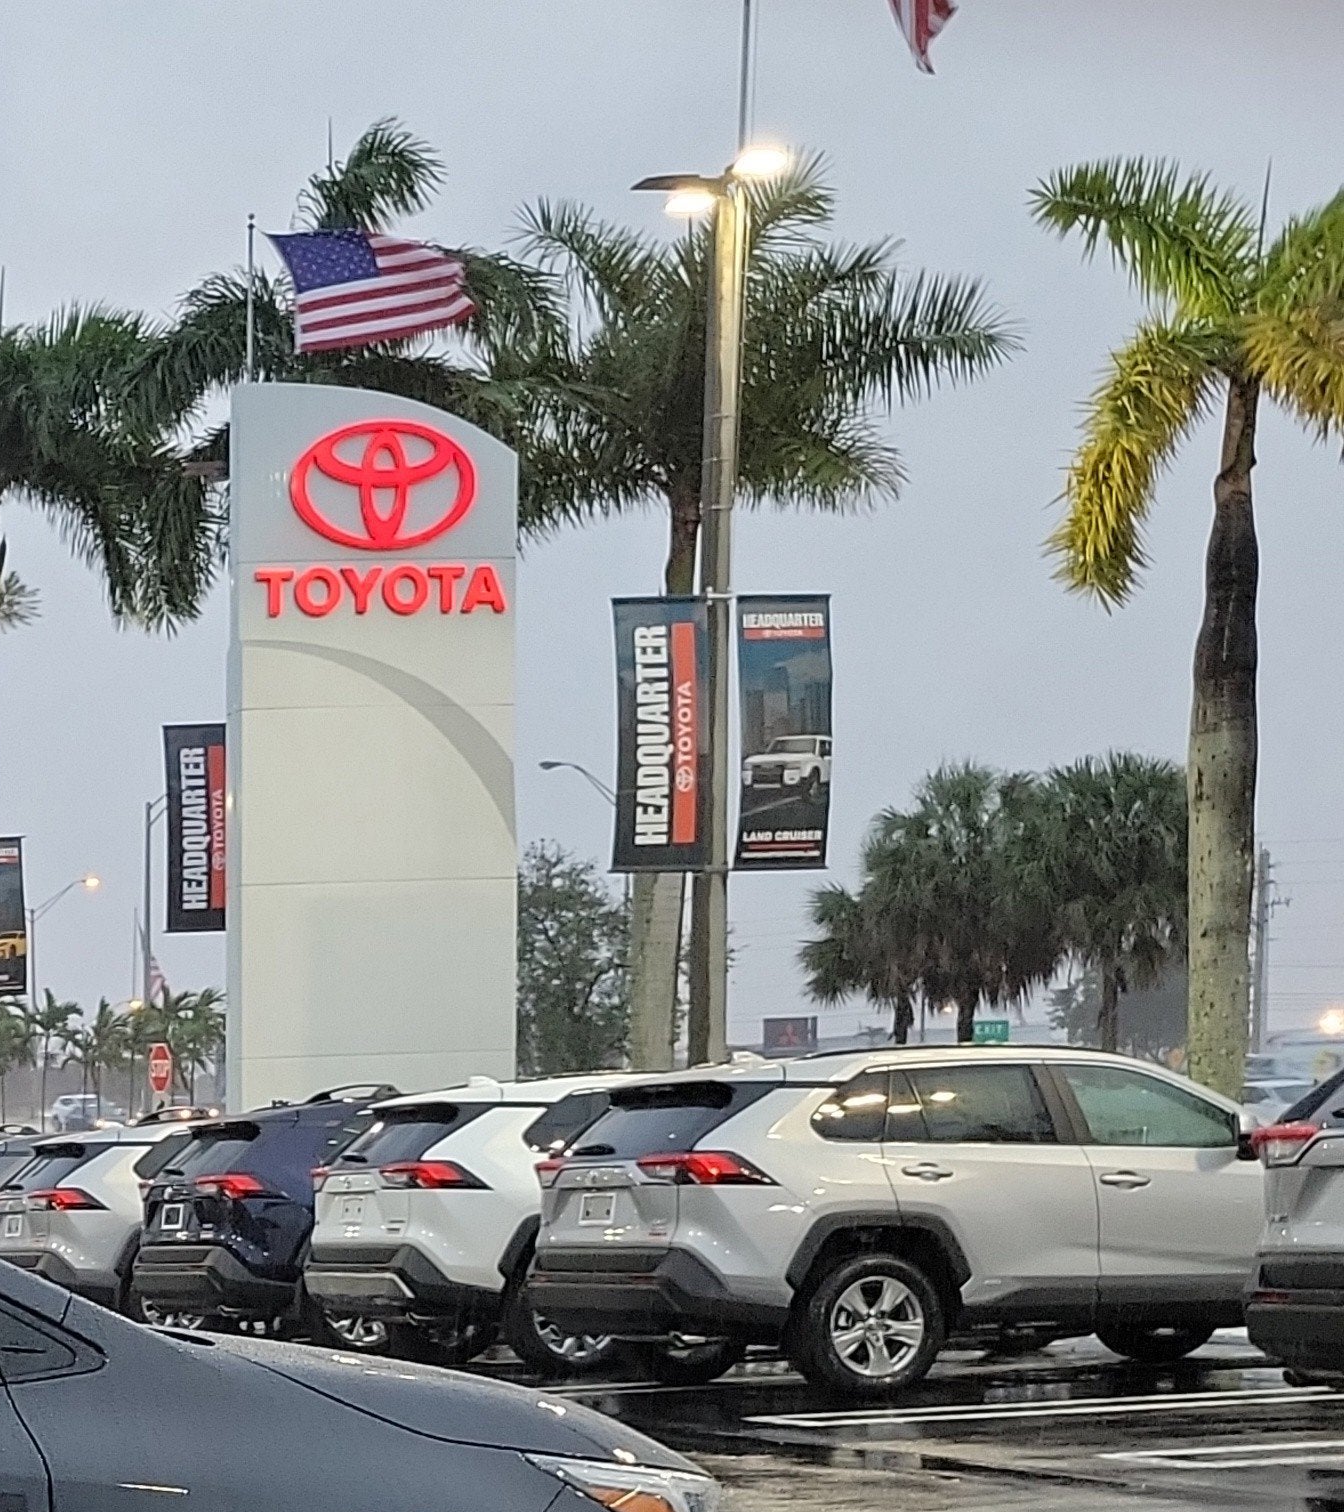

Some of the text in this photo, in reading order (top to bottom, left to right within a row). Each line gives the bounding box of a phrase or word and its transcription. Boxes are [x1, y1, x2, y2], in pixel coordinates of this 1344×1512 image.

[255, 565, 506, 617] TOYOTA
[633, 625, 674, 846] HEADQUARTER
[677, 681, 693, 766] TOYOTA
[180, 747, 211, 910] HEADQUARTER
[212, 788, 225, 848] TOYOTA
[152, 1059, 169, 1077] STOP
